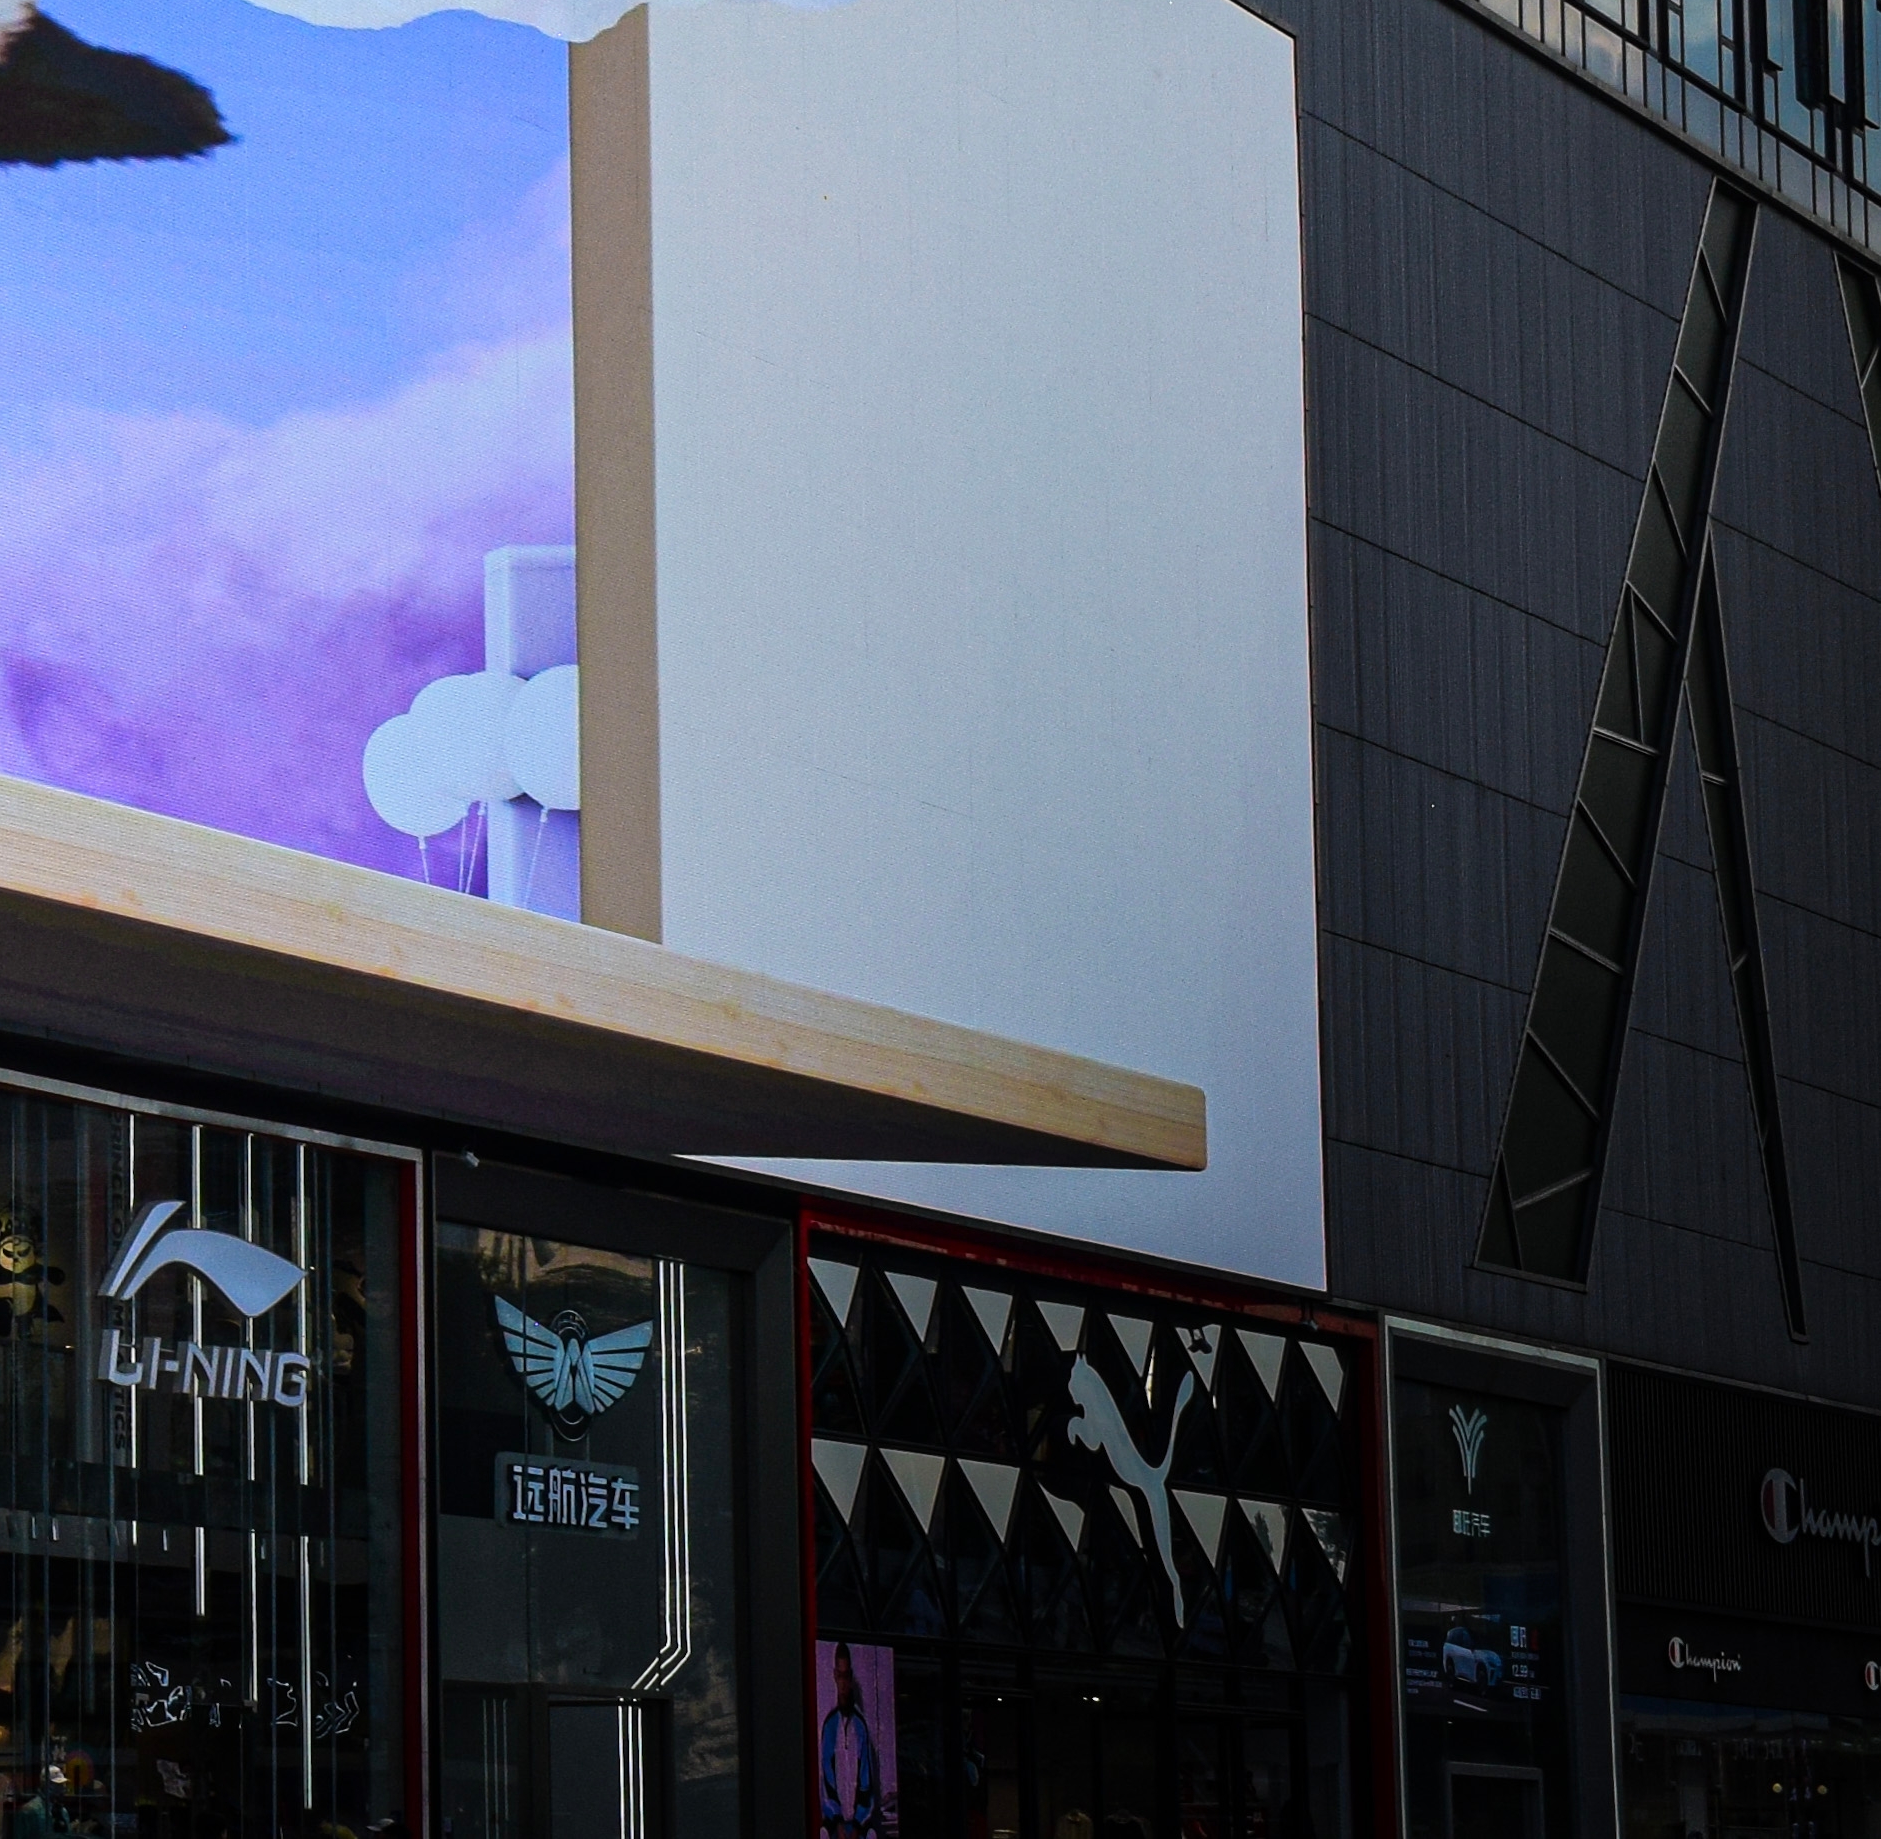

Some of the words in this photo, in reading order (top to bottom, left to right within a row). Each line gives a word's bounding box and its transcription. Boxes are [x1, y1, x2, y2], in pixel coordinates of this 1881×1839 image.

[99, 1328, 312, 1408] LI-NING
[511, 1463, 640, 1531] 远航汽车
[1668, 1636, 1741, 1684] Champion
